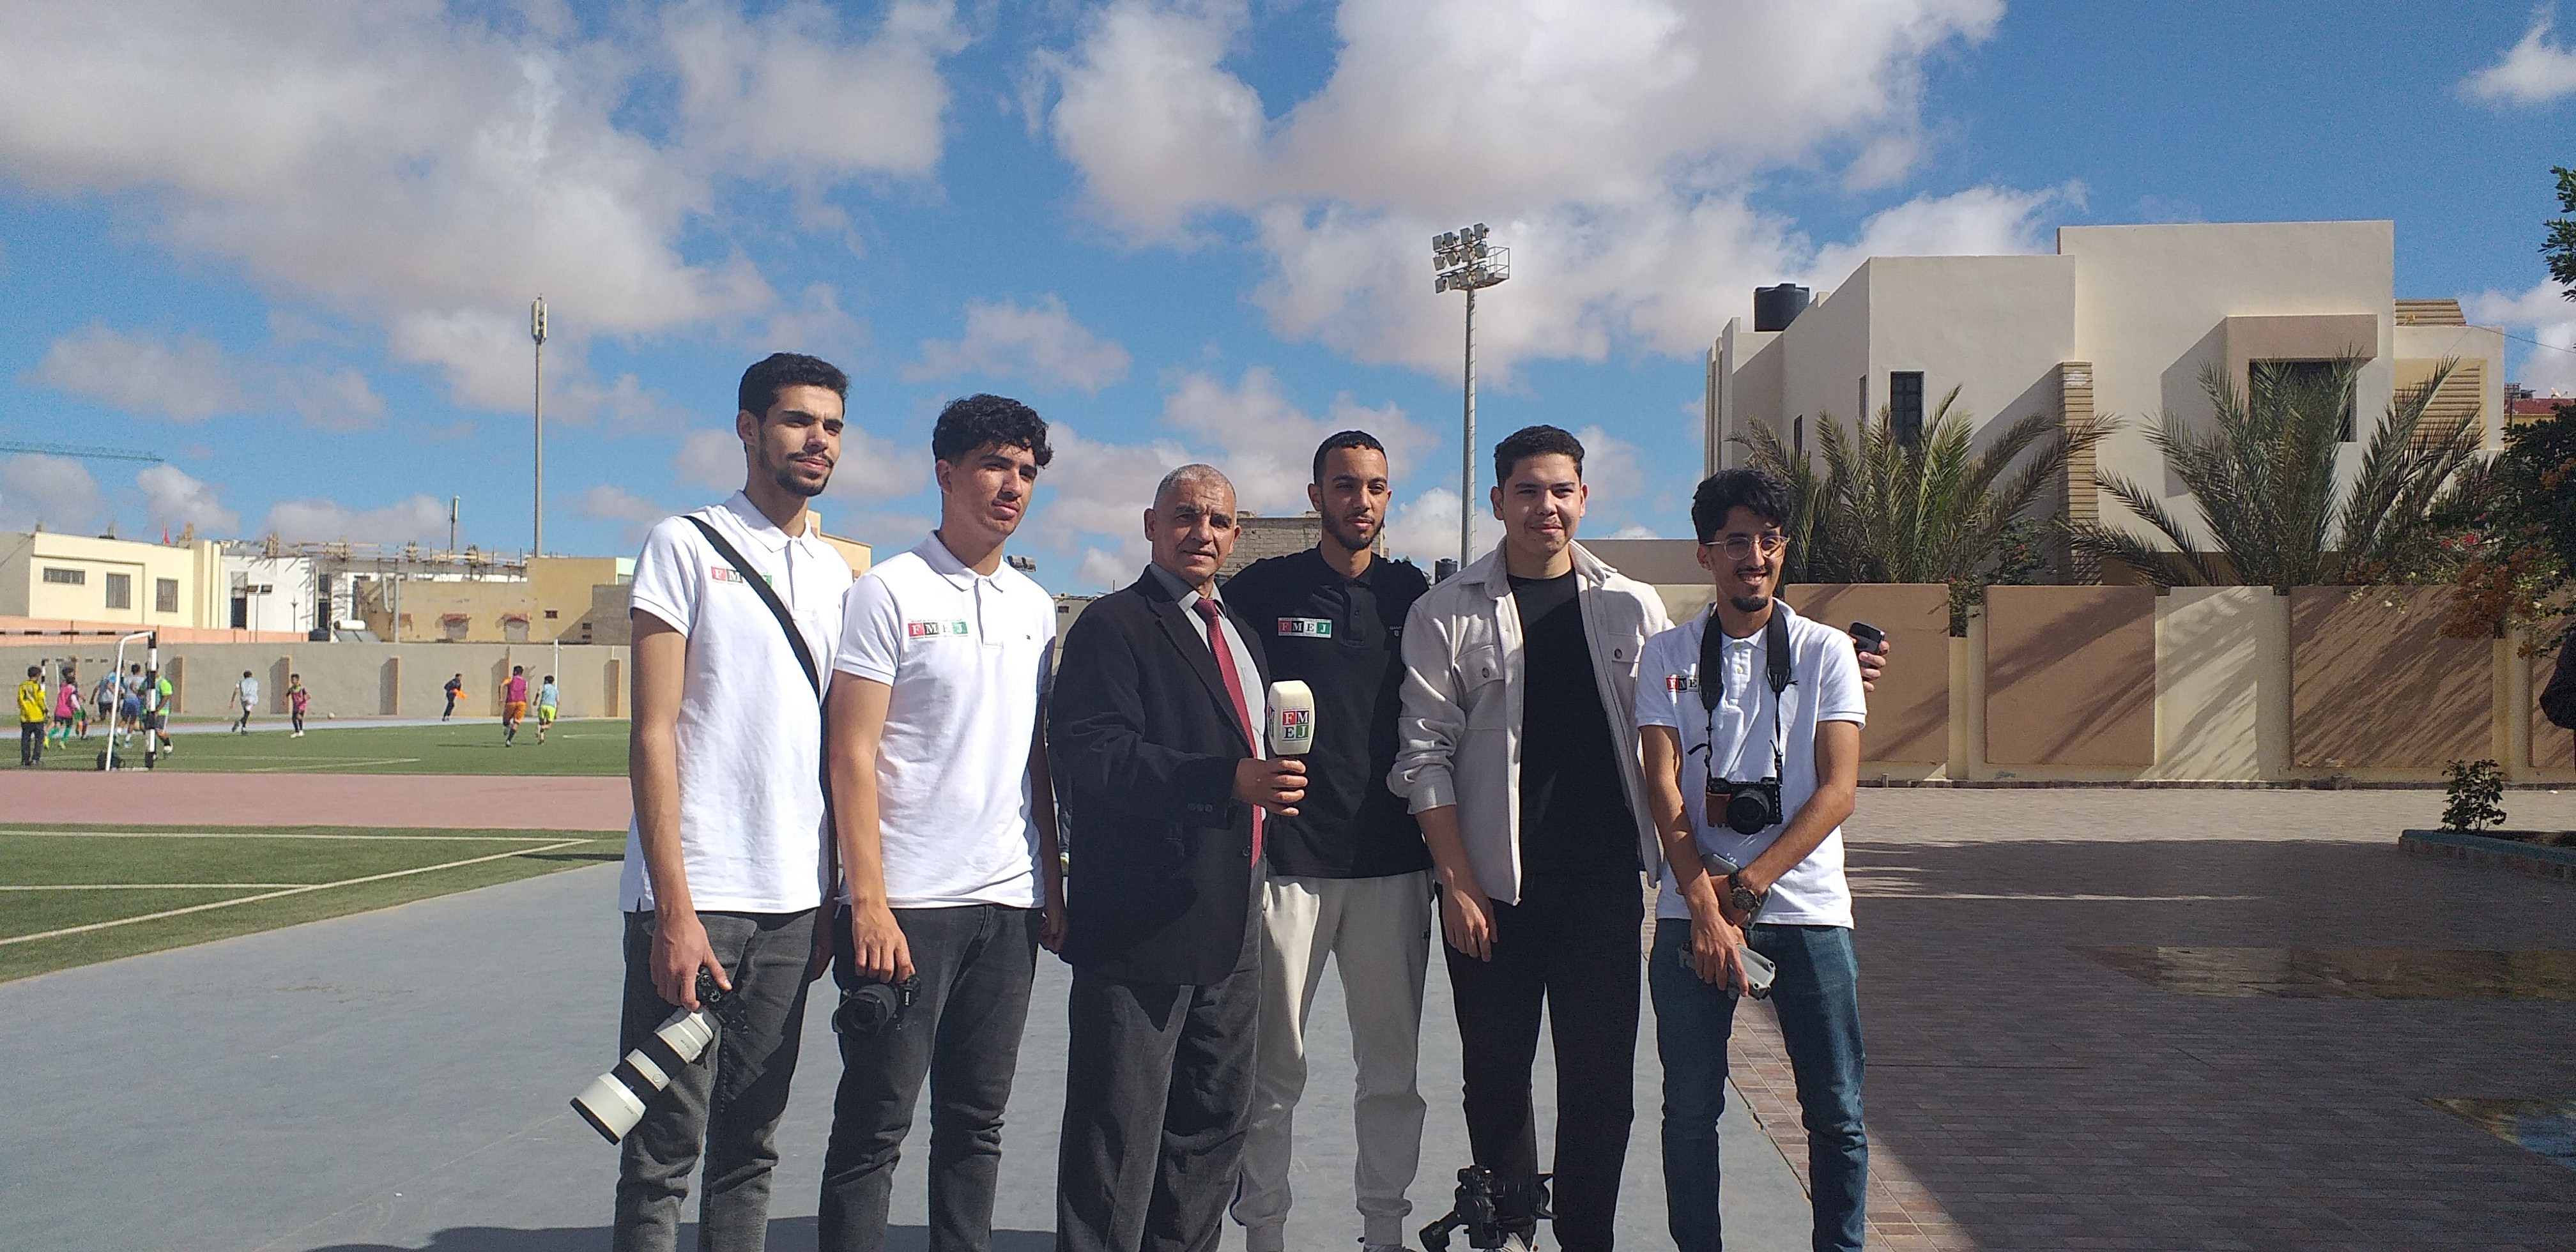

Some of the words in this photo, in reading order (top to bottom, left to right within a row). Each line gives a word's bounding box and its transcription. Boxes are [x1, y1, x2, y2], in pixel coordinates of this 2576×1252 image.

[912, 623, 963, 635] FMEJ
[1282, 622, 1327, 632] FMEJ
[1669, 678, 1698, 688] FME
[1284, 712, 1308, 724] FM
[1284, 726, 1307, 738] EJ
